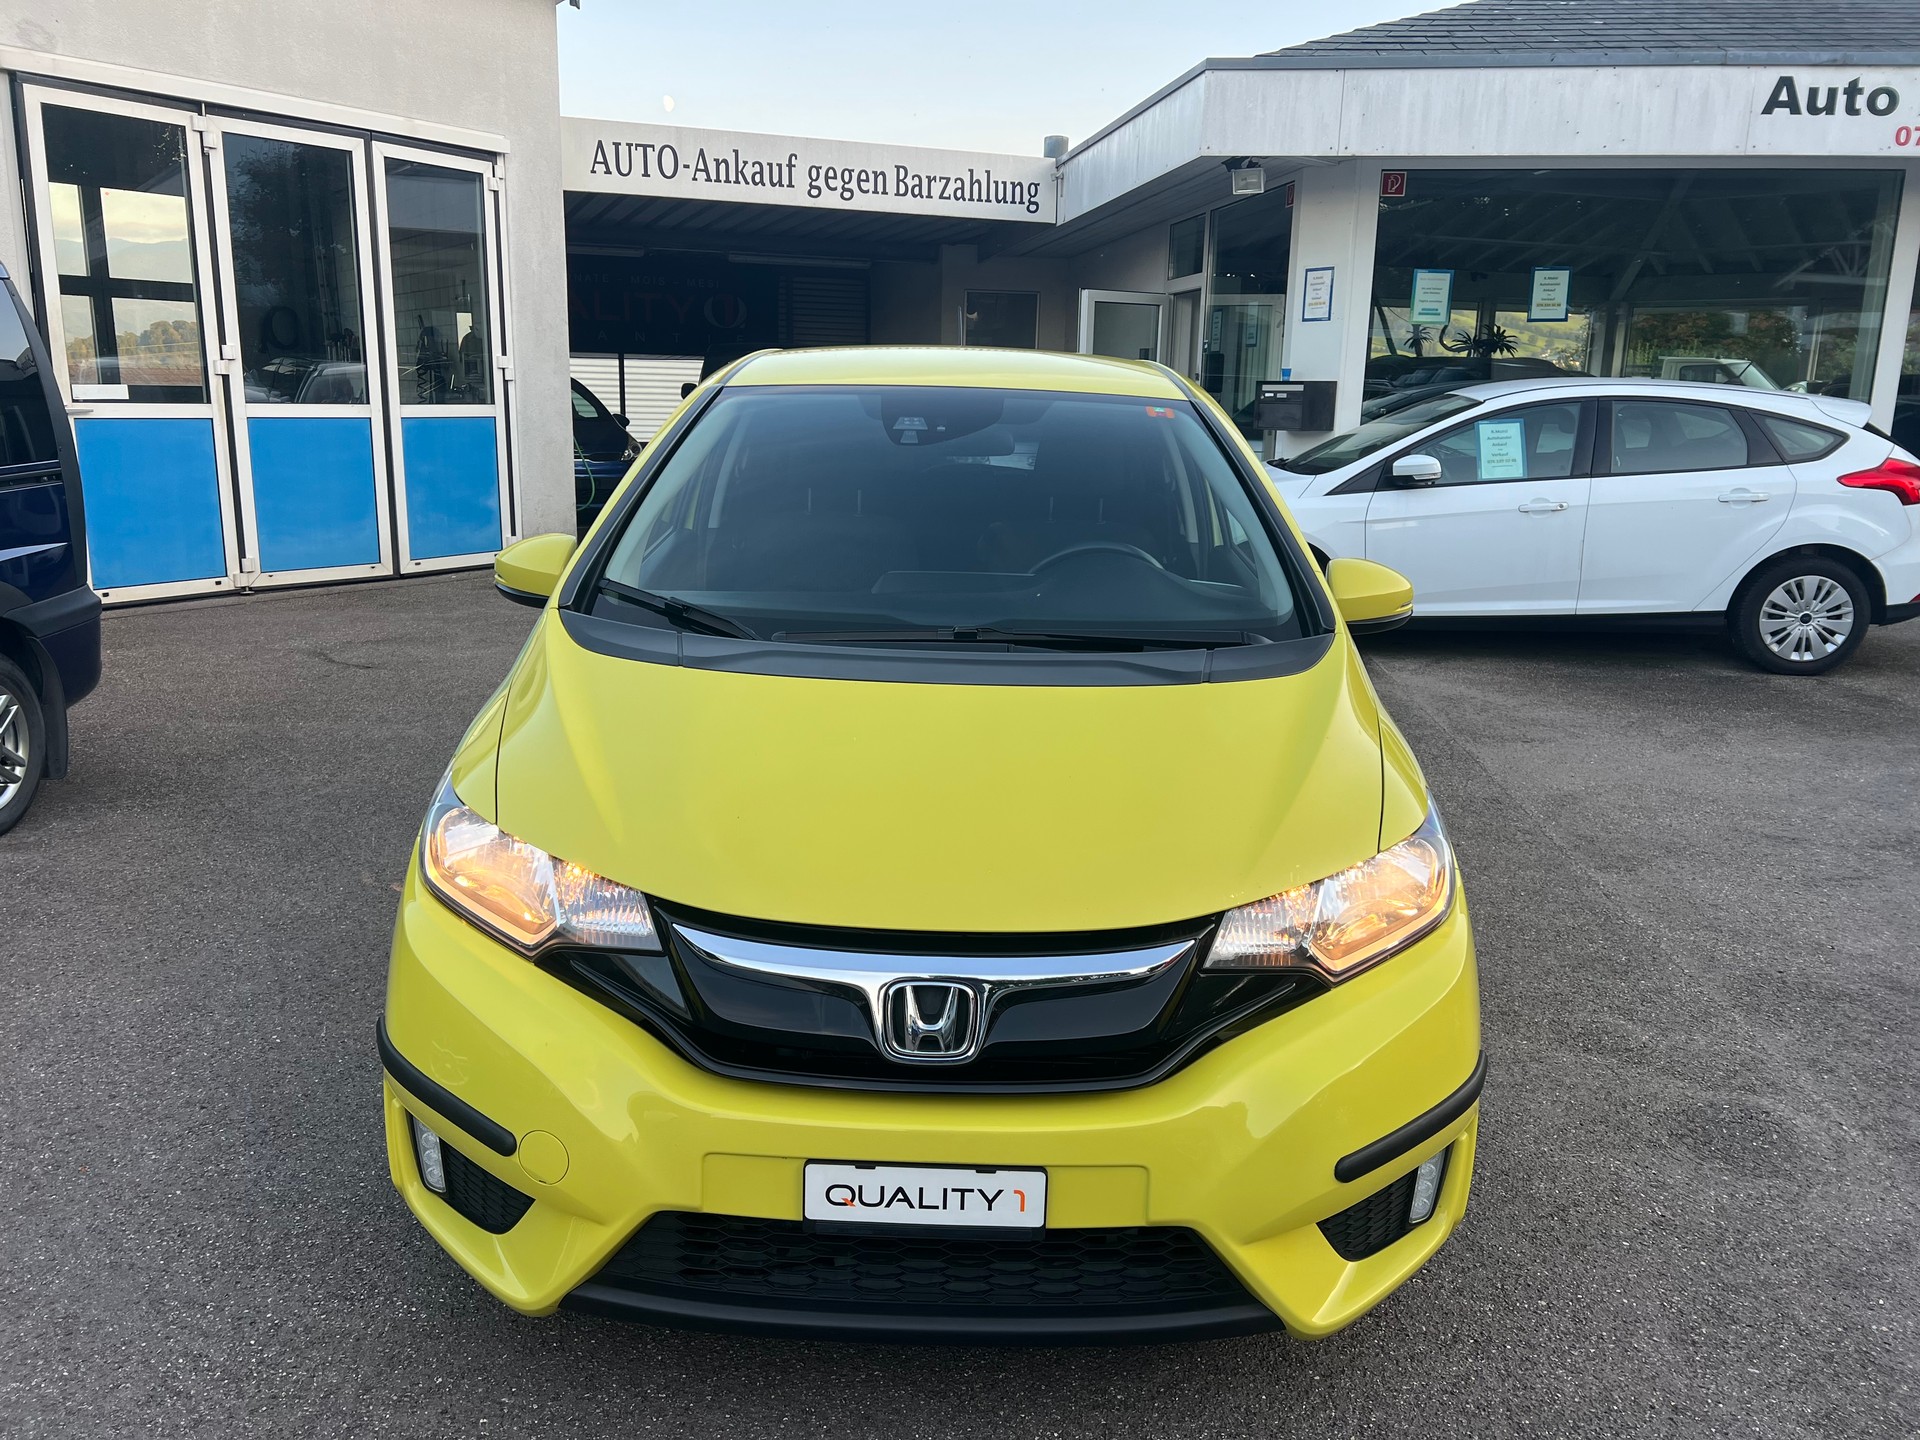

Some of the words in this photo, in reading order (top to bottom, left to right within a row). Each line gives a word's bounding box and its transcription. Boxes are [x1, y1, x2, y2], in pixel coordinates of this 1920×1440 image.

[1761, 75, 1900, 117] Auto
[590, 139, 797, 188] AUTO-Ankauf
[807, 164, 888, 201] gegen
[894, 165, 1040, 214] Barzahlung
[825, 1184, 1004, 1211] QUALITY
[1013, 1189, 1025, 1212] 1
